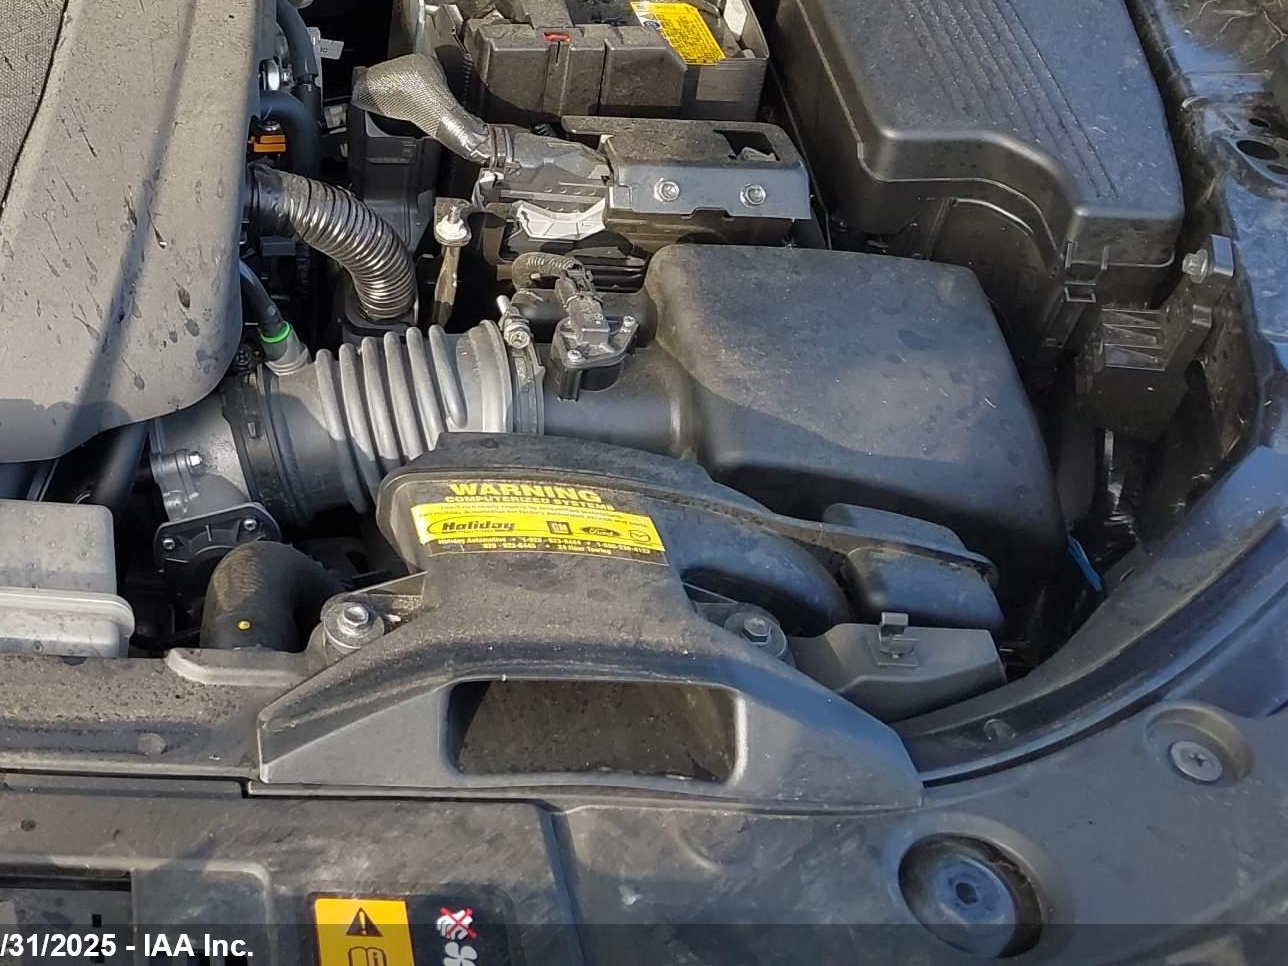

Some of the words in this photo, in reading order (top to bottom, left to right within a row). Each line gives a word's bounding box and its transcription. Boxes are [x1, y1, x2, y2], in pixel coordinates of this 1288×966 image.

[449, 483, 603, 504] WARNING
[444, 495, 551, 505] COMPUTERIZED
[553, 497, 616, 512] SYSTEMS
[441, 520, 516, 534] Holiday
[588, 527, 615, 537] Ford
[438, 537, 465, 545] Holiday
[466, 536, 507, 544] Automotive
